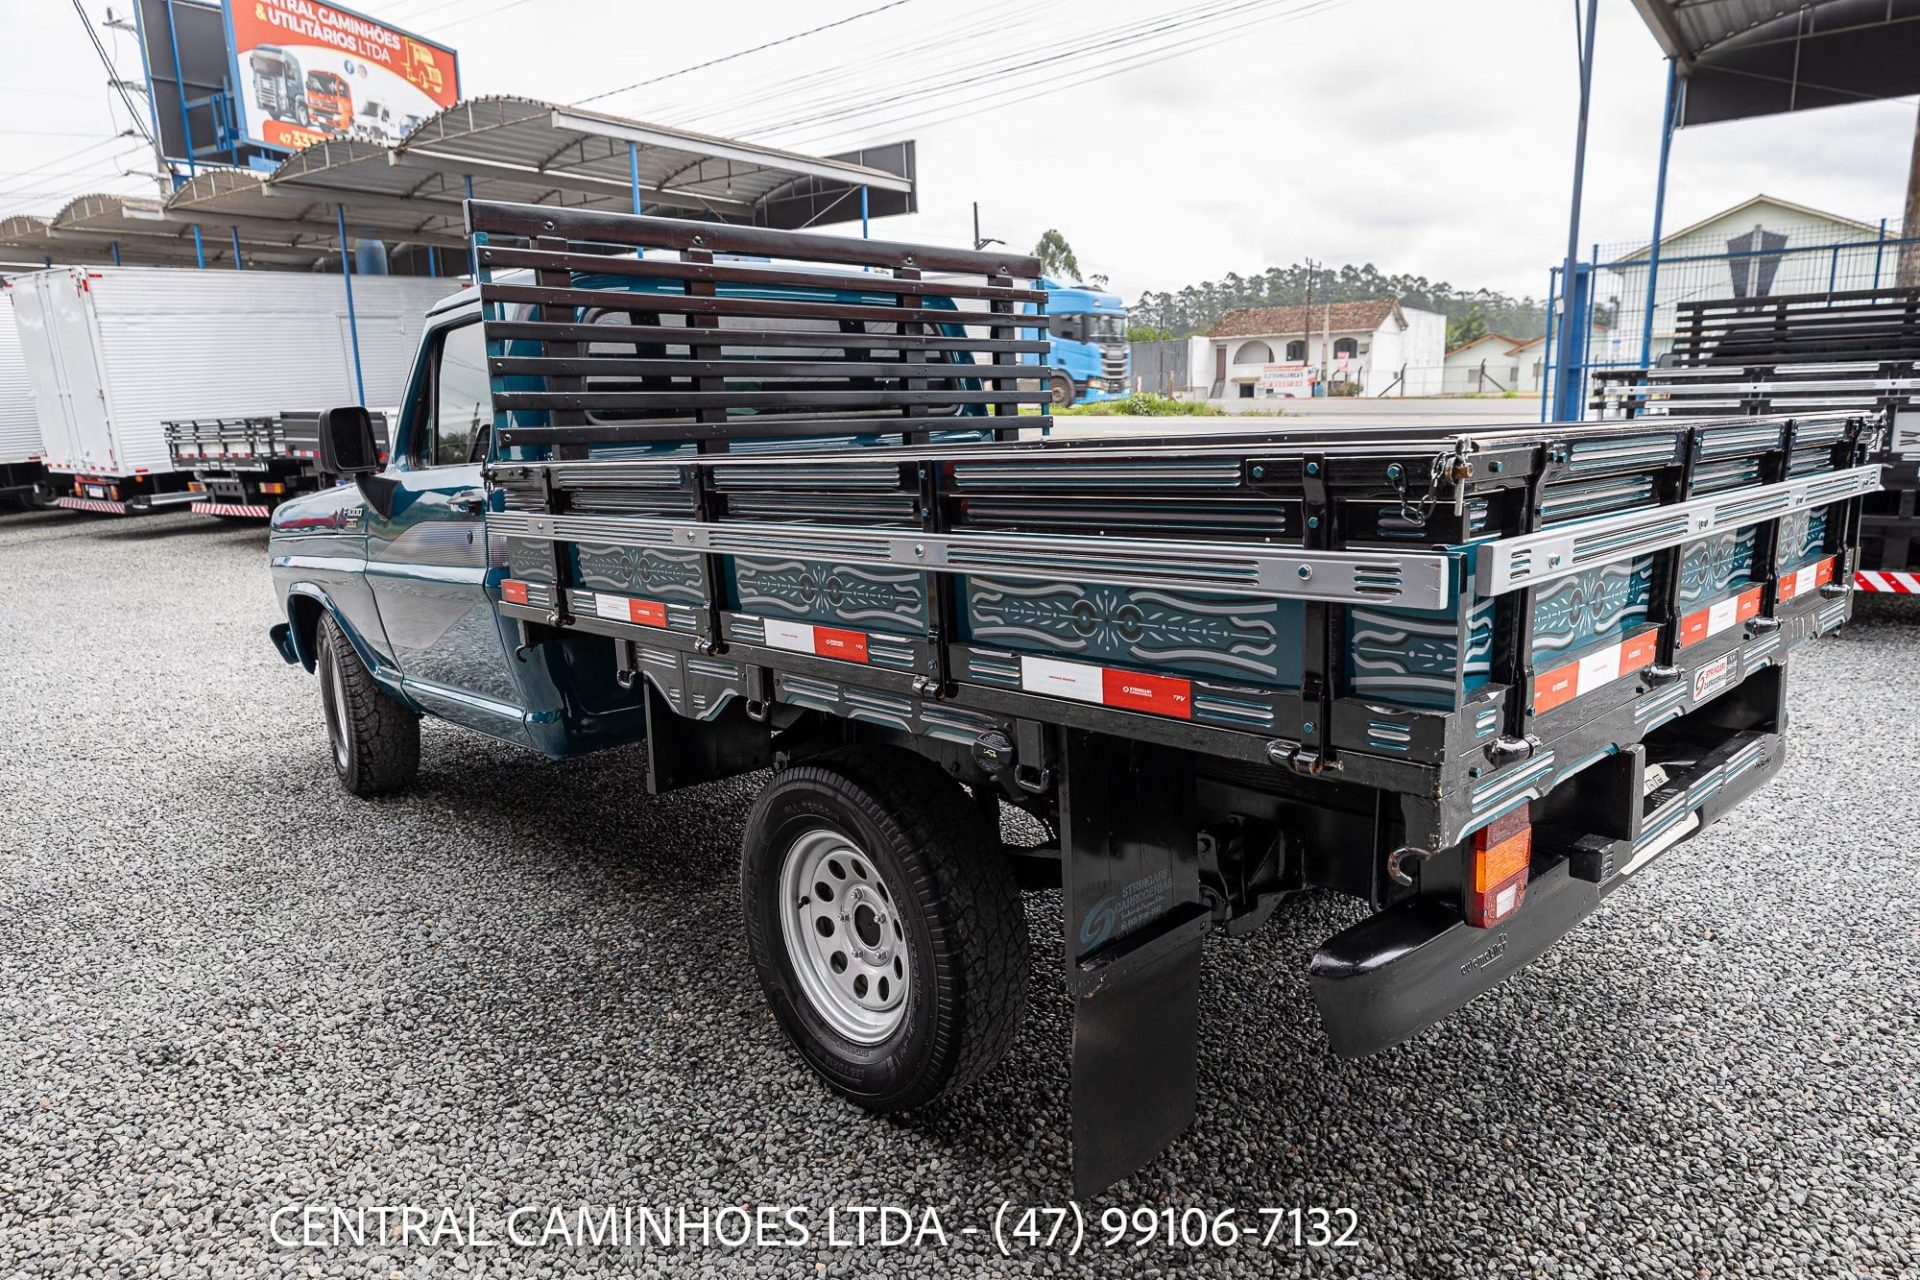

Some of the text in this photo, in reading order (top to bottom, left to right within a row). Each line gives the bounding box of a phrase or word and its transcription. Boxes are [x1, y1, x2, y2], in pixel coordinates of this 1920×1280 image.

[255, 3, 391, 64] & UTILITÁRIOS LTDA
[318, 7, 401, 50] CAMINHÕES
